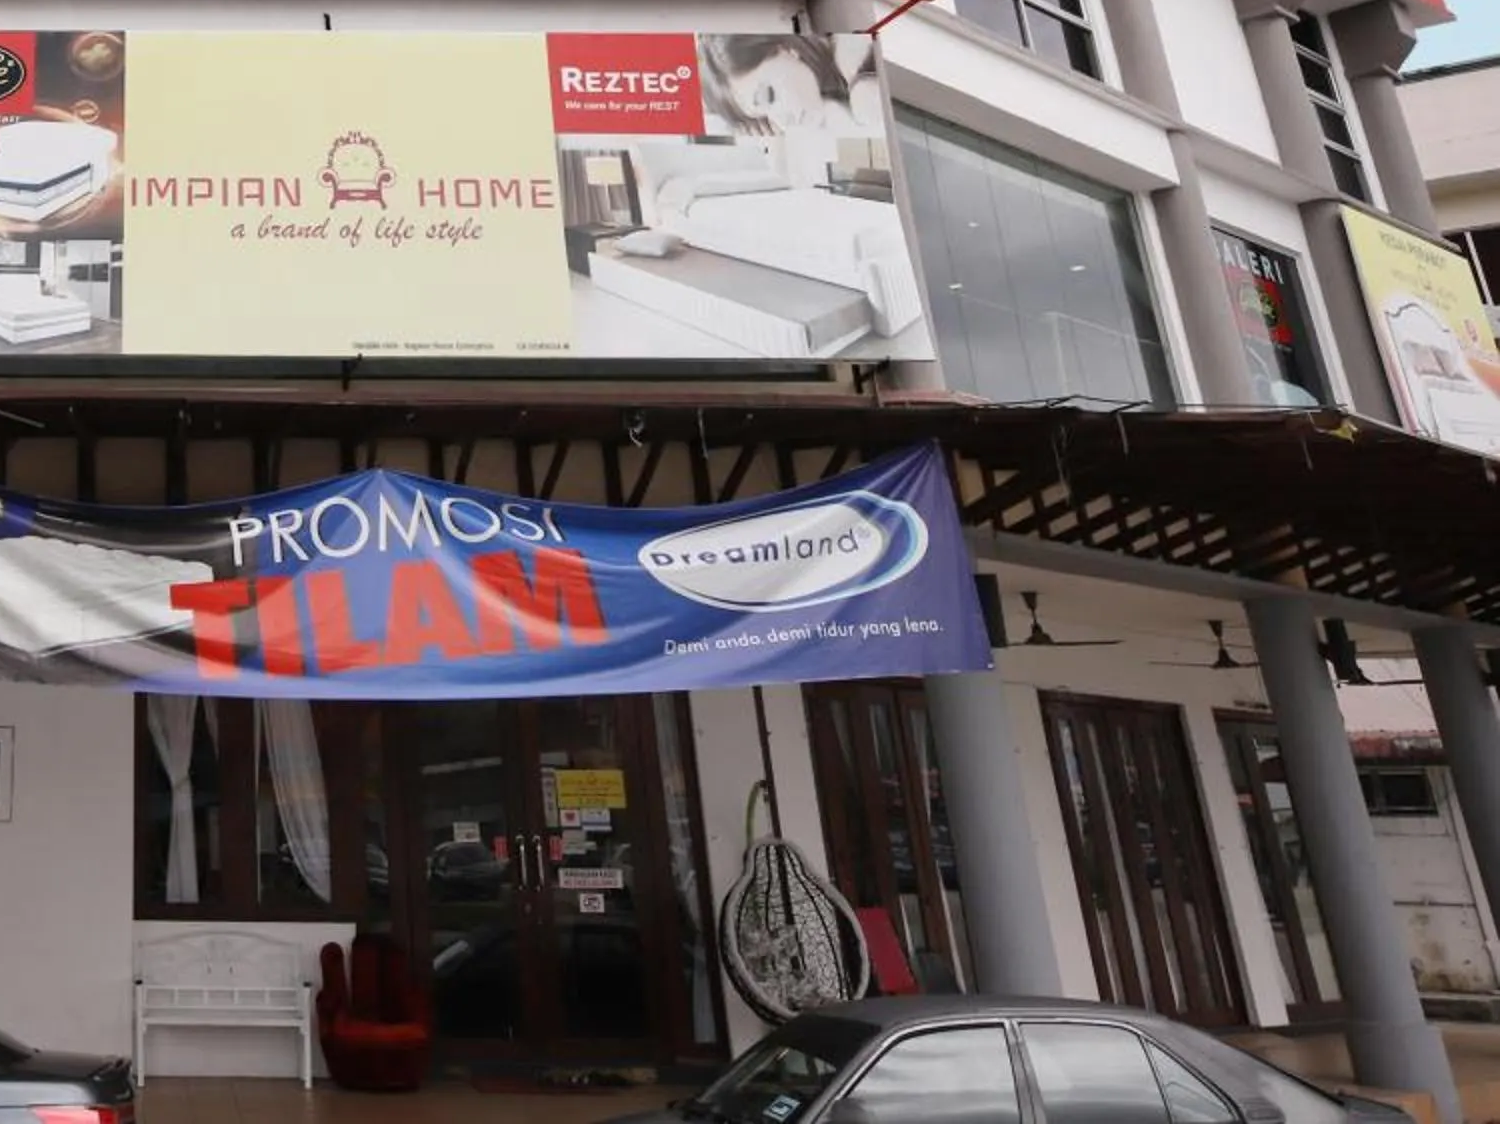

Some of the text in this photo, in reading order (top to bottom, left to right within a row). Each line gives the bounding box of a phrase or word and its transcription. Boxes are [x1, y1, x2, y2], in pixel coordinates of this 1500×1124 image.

[560, 66, 680, 94] REZTEC
[130, 176, 555, 209] IMPIAN HOME
[230, 214, 483, 248] a brand of life style
[1215, 240, 1285, 284] ALERI
[228, 490, 567, 568] PROMOSI
[650, 529, 859, 567] Dreamland
[169, 548, 611, 680] TILAM
[664, 639, 709, 656] Demi
[768, 623, 812, 645] demi
[816, 623, 855, 638] tidur
[859, 620, 901, 641] yang
[904, 616, 944, 633] lena.
